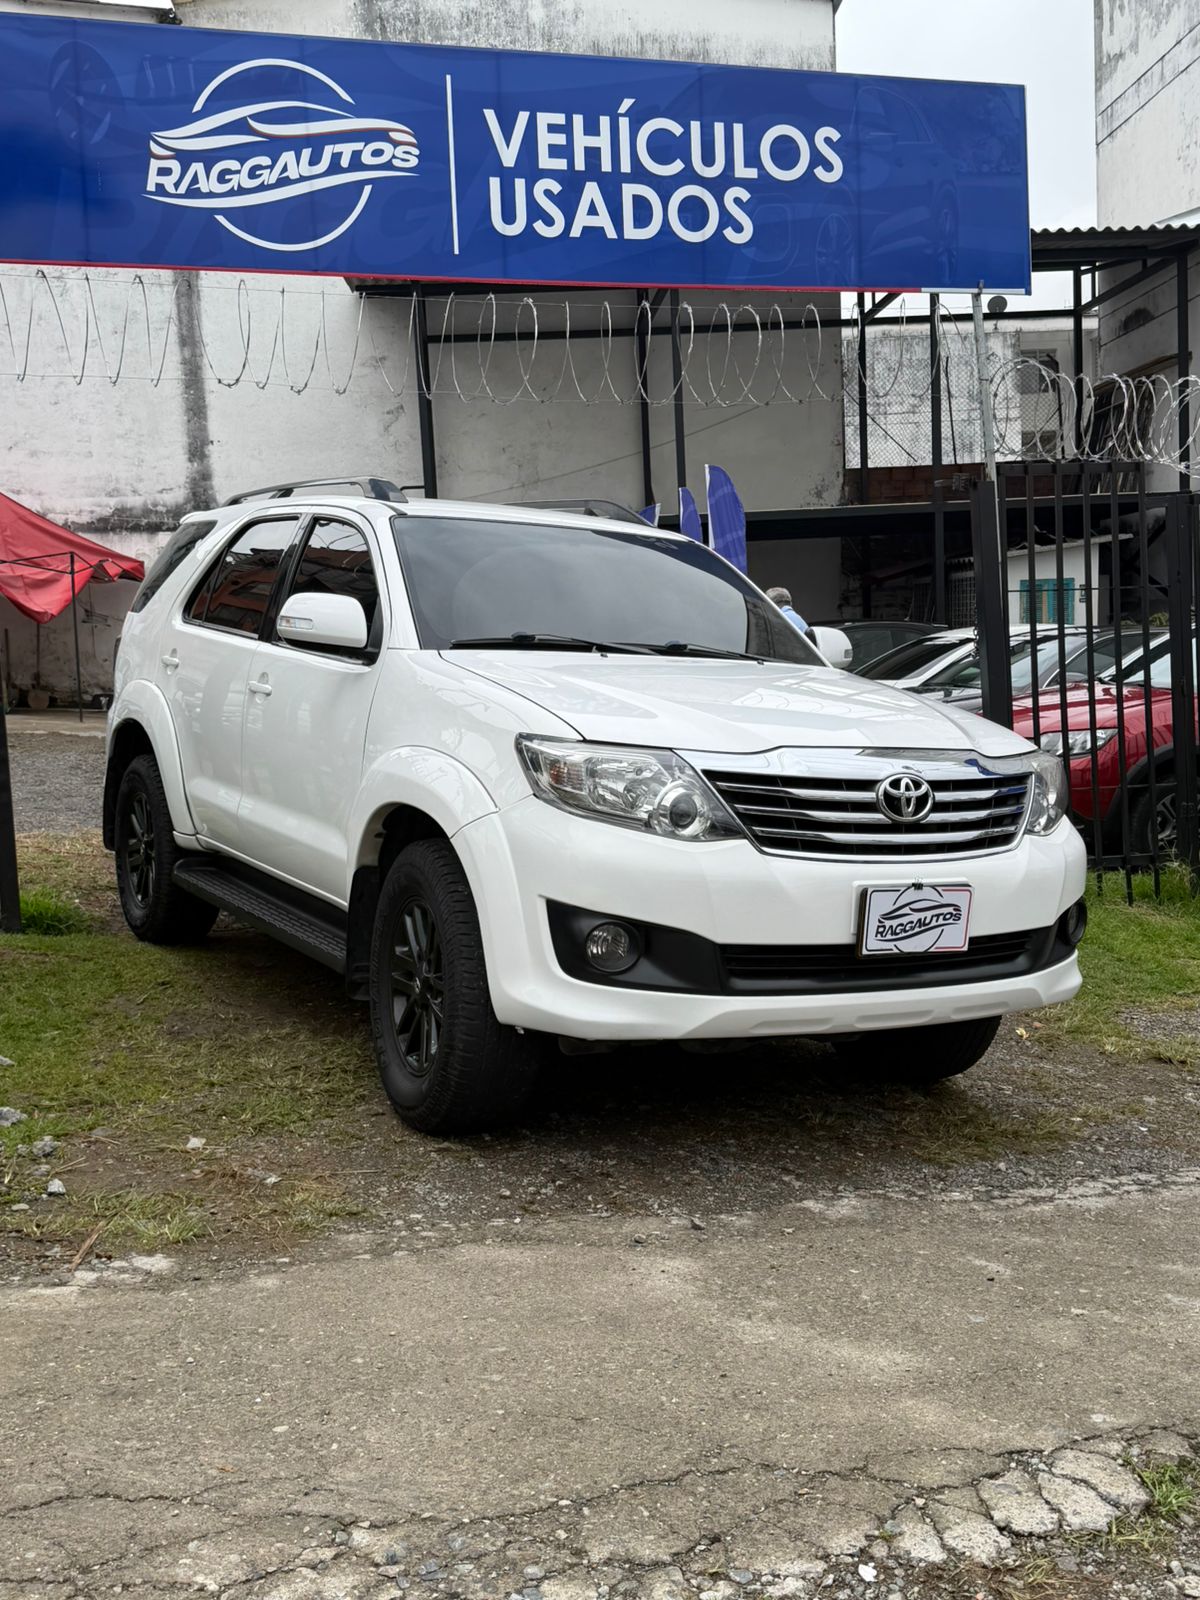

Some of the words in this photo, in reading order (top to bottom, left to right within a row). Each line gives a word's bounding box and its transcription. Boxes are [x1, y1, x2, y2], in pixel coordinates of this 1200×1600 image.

[146, 141, 420, 195] RAGGAUTOS
[482, 98, 844, 184] VEHÍCULOS
[489, 176, 754, 244] USADOS
[874, 911, 962, 938] RAGGAUTOS
